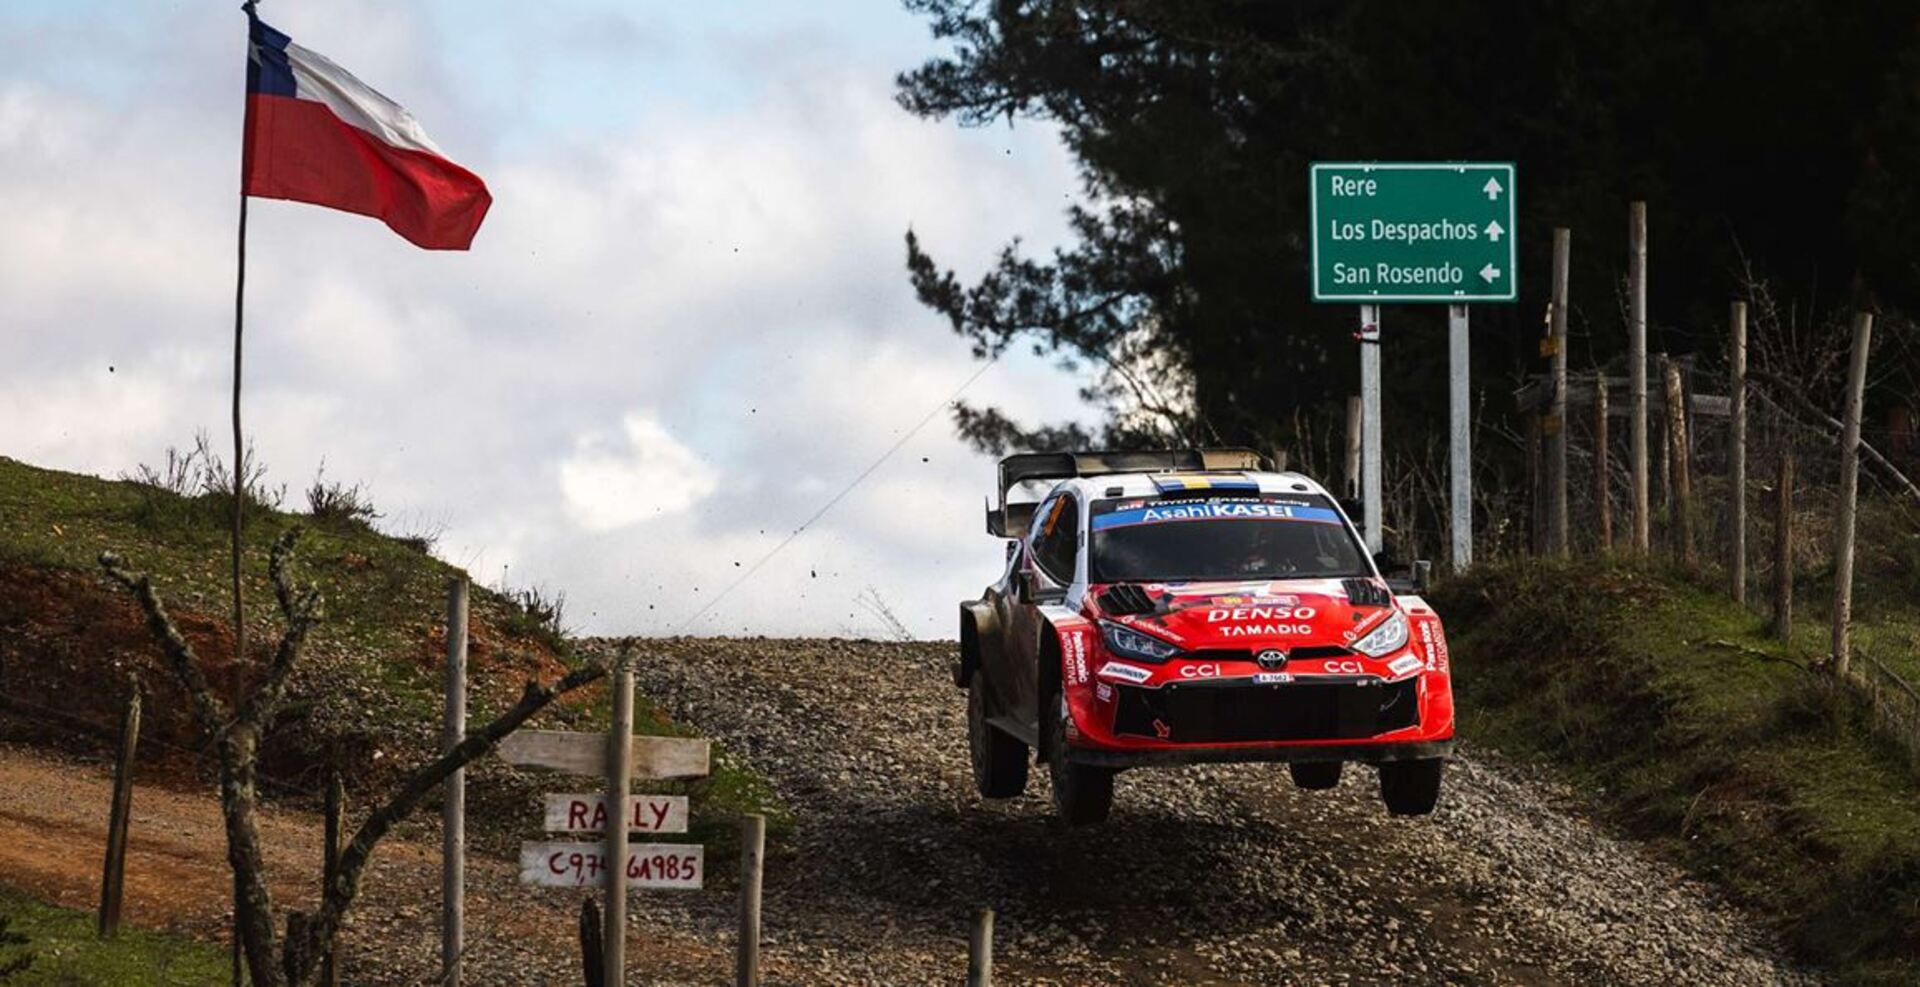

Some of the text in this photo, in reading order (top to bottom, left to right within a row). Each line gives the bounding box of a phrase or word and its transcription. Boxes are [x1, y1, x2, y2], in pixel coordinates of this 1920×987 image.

[1331, 175, 1377, 197] Rere
[1331, 218, 1477, 245] Los Despachos
[1333, 262, 1463, 284] San Rosendo
[1207, 607, 1316, 622] DENSO
[1219, 624, 1312, 637] TAMADIC
[1180, 664, 1221, 677] CCI
[1324, 661, 1364, 673] CCI
[568, 800, 671, 830] RALY
